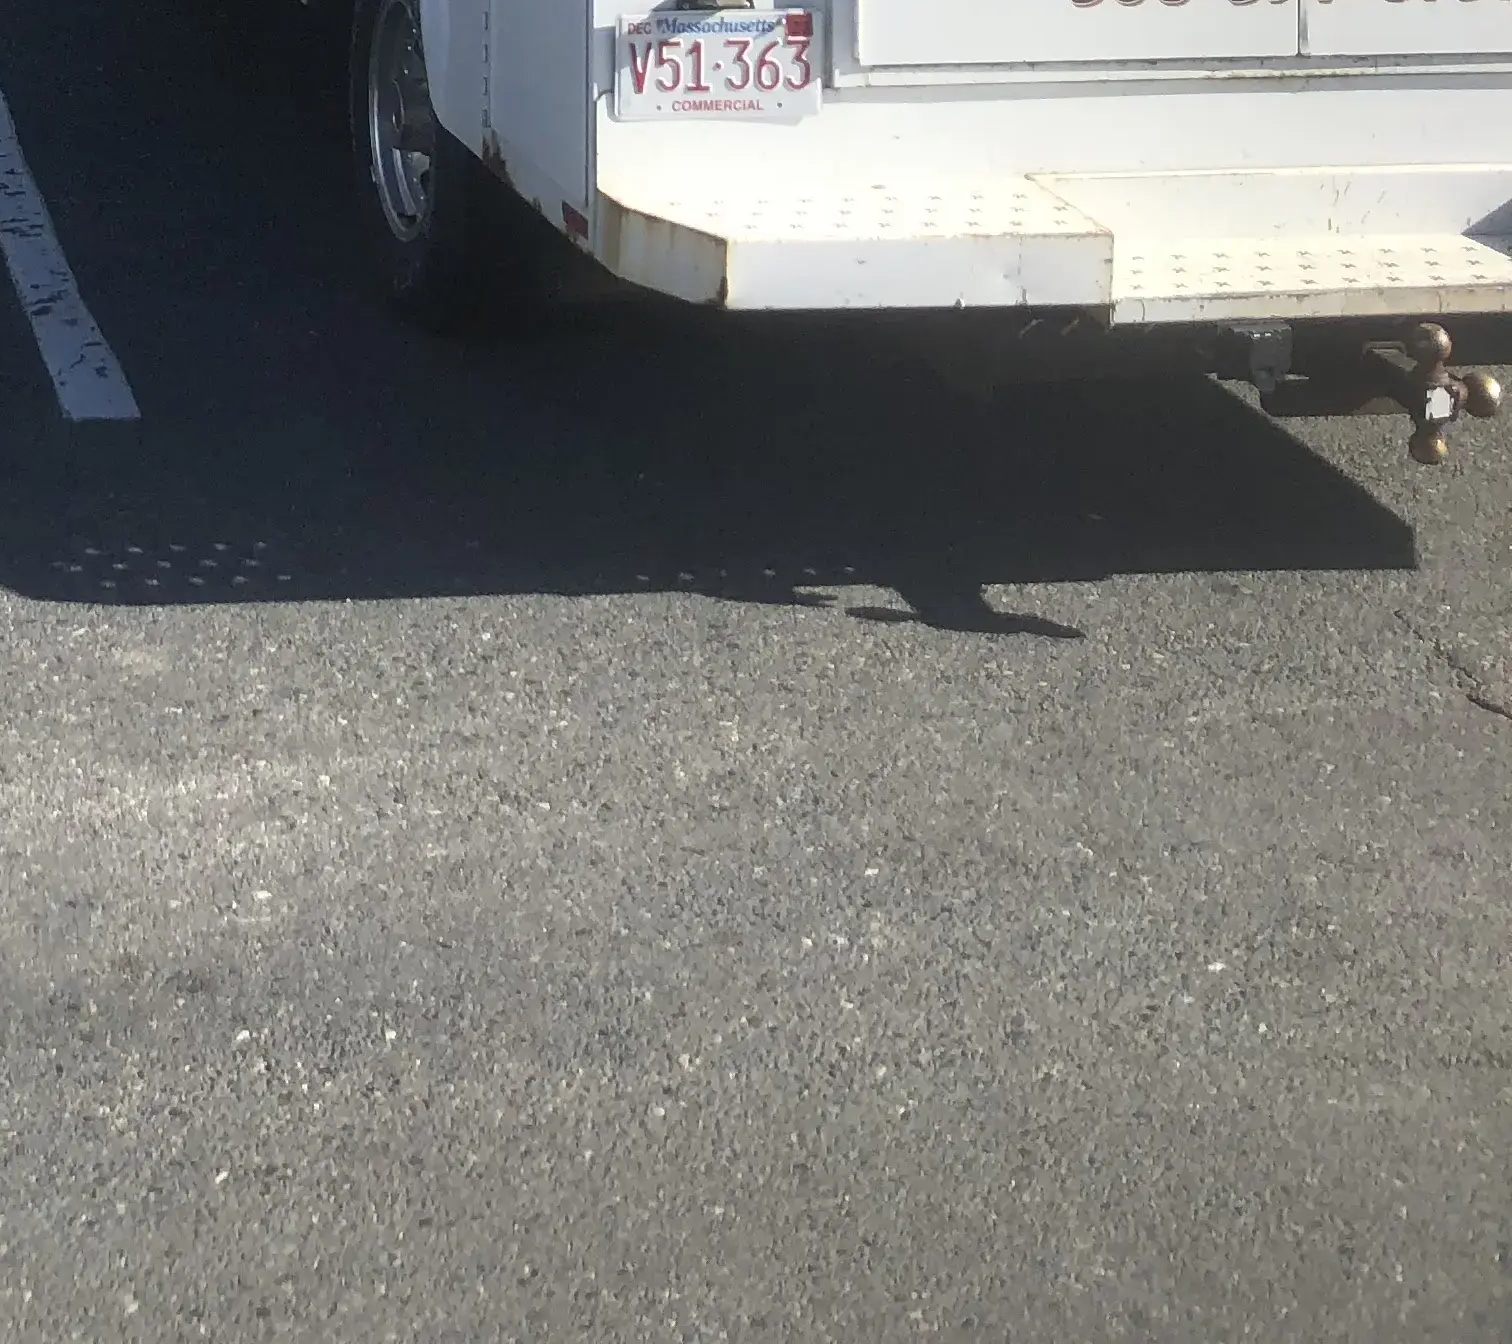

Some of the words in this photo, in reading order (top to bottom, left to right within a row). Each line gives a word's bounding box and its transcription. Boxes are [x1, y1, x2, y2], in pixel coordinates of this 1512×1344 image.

[628, 21, 652, 35] DEC
[660, 16, 775, 35] Massachusetts
[671, 99, 764, 112] COMMERCIAL
